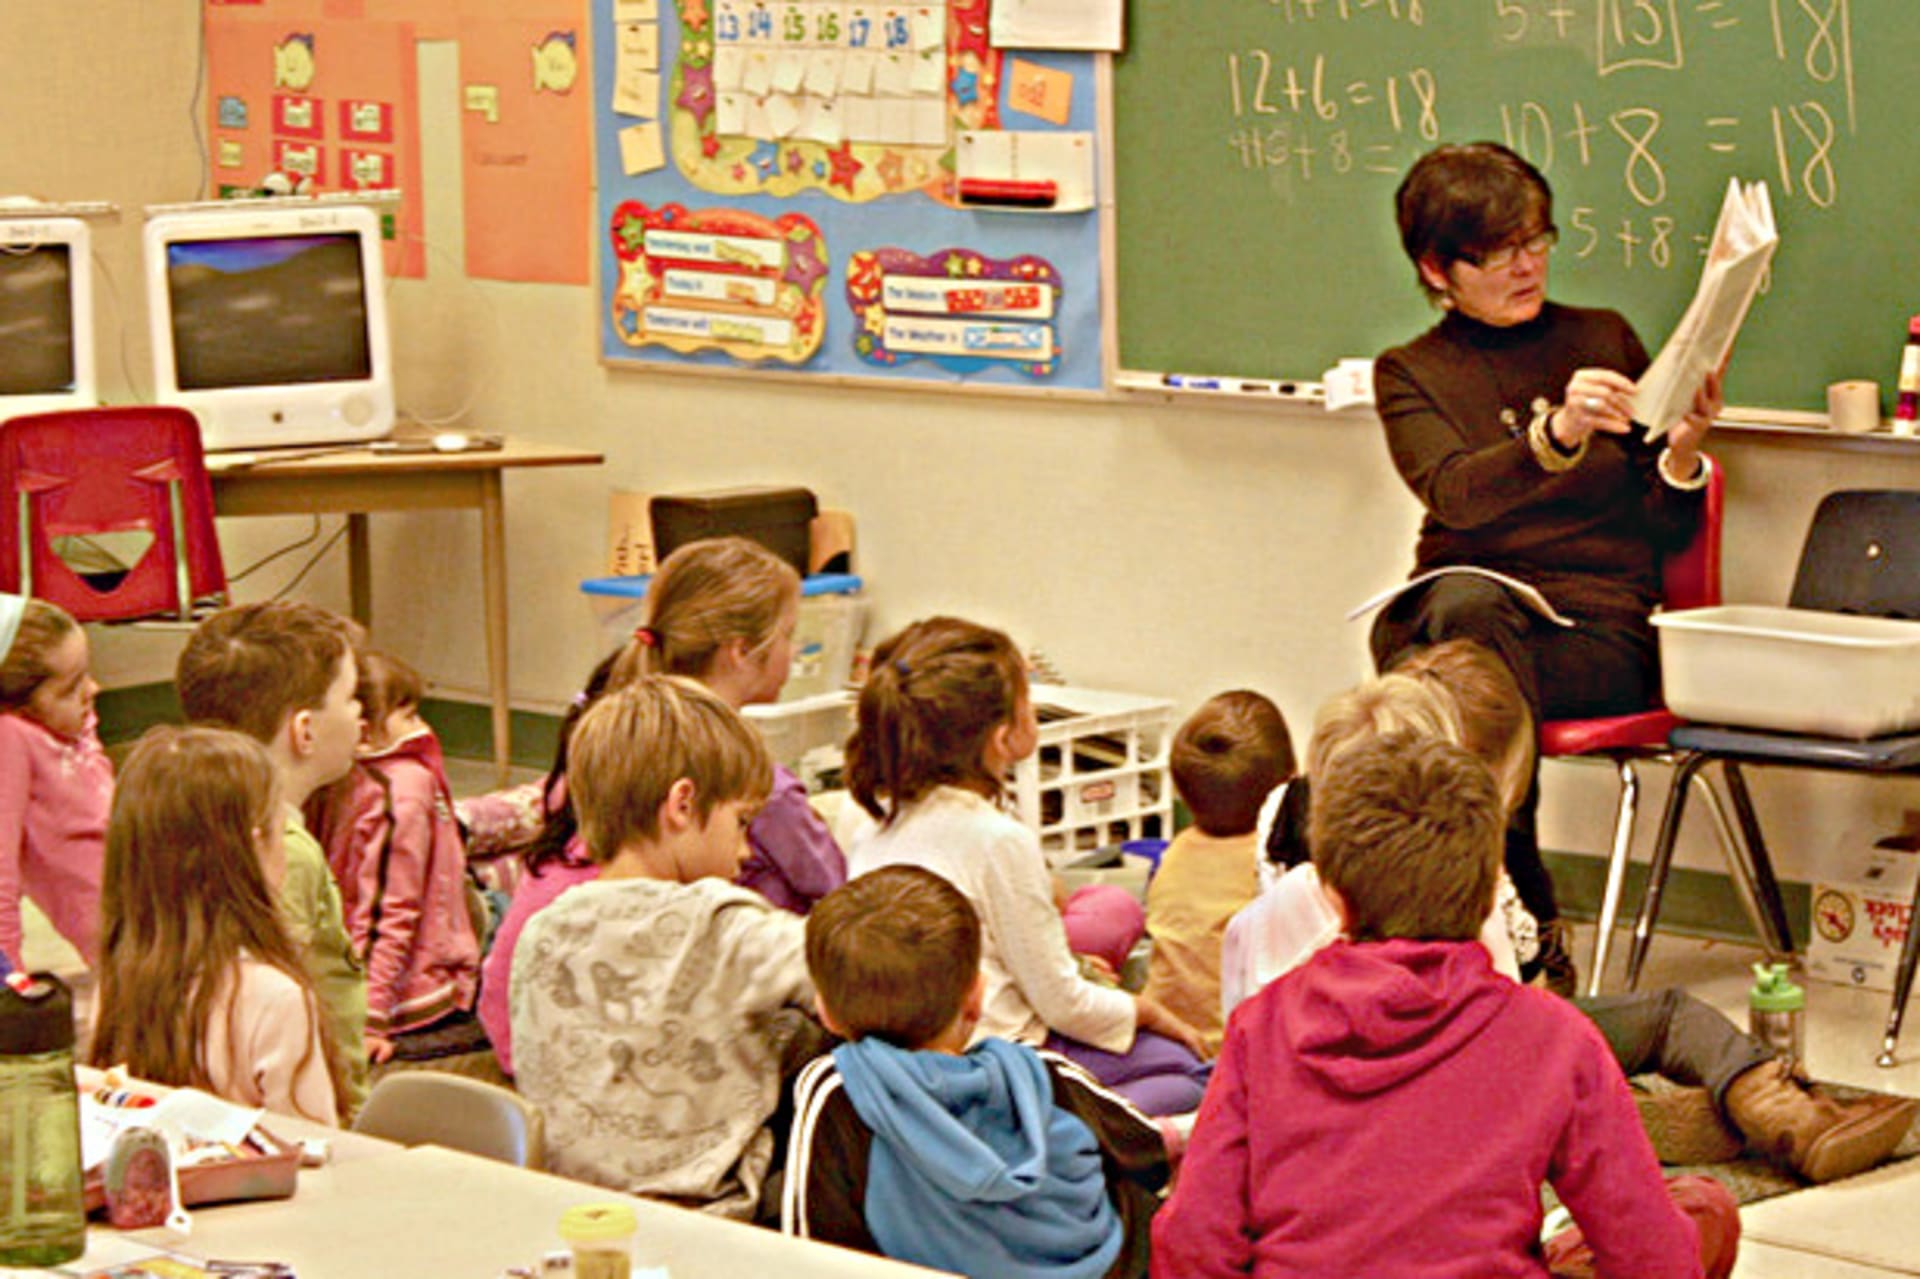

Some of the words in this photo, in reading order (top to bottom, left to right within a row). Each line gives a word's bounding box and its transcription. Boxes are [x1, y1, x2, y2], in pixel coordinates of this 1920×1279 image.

[717, 13, 740, 41] 13
[748, 11, 772, 38] 14
[783, 15, 806, 41] 15
[816, 12, 840, 41] 16
[849, 18, 871, 47] 17
[1771, 0, 1838, 81] 18
[1608, 107, 1667, 207] 8
[1771, 101, 1836, 208] 18
